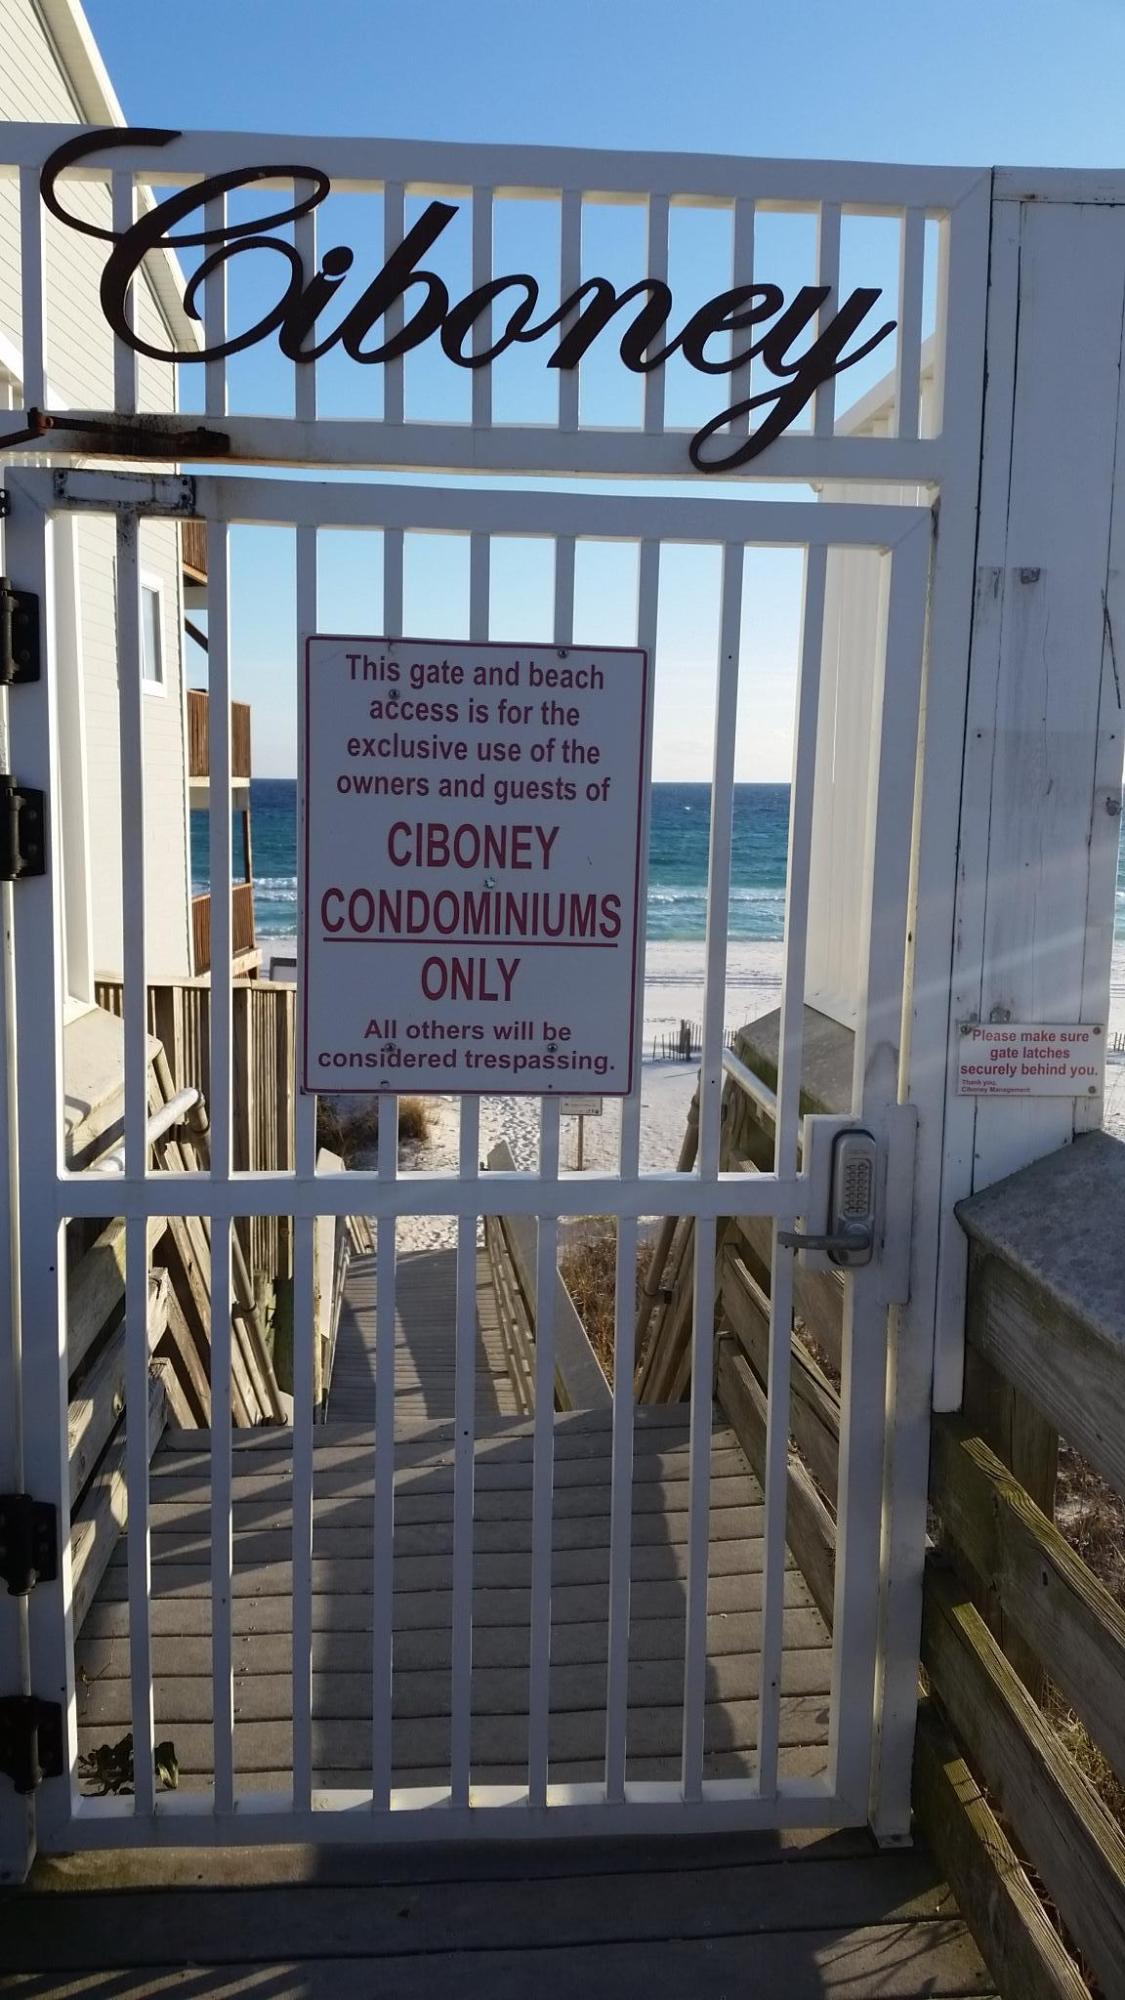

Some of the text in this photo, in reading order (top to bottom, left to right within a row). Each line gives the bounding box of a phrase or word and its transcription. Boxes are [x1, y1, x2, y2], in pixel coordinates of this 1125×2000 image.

[41, 126, 898, 473] Ciboney
[346, 654, 605, 690] This gate and beach
[370, 698, 580, 726] access is for the
[347, 734, 600, 764] exclusive use of the
[336, 773, 610, 805] owners and guests of
[388, 821, 560, 870] CIBONEY
[321, 888, 622, 938] CONDOMINIUMS
[421, 957, 521, 1002] ONLY
[364, 1019, 572, 1041] All others will be
[973, 1029, 1089, 1042] Please make sure
[319, 1047, 615, 1075] considered trespassing.
[990, 1047, 1070, 1060] gate latches
[961, 1064, 1098, 1077] securely behind you.
